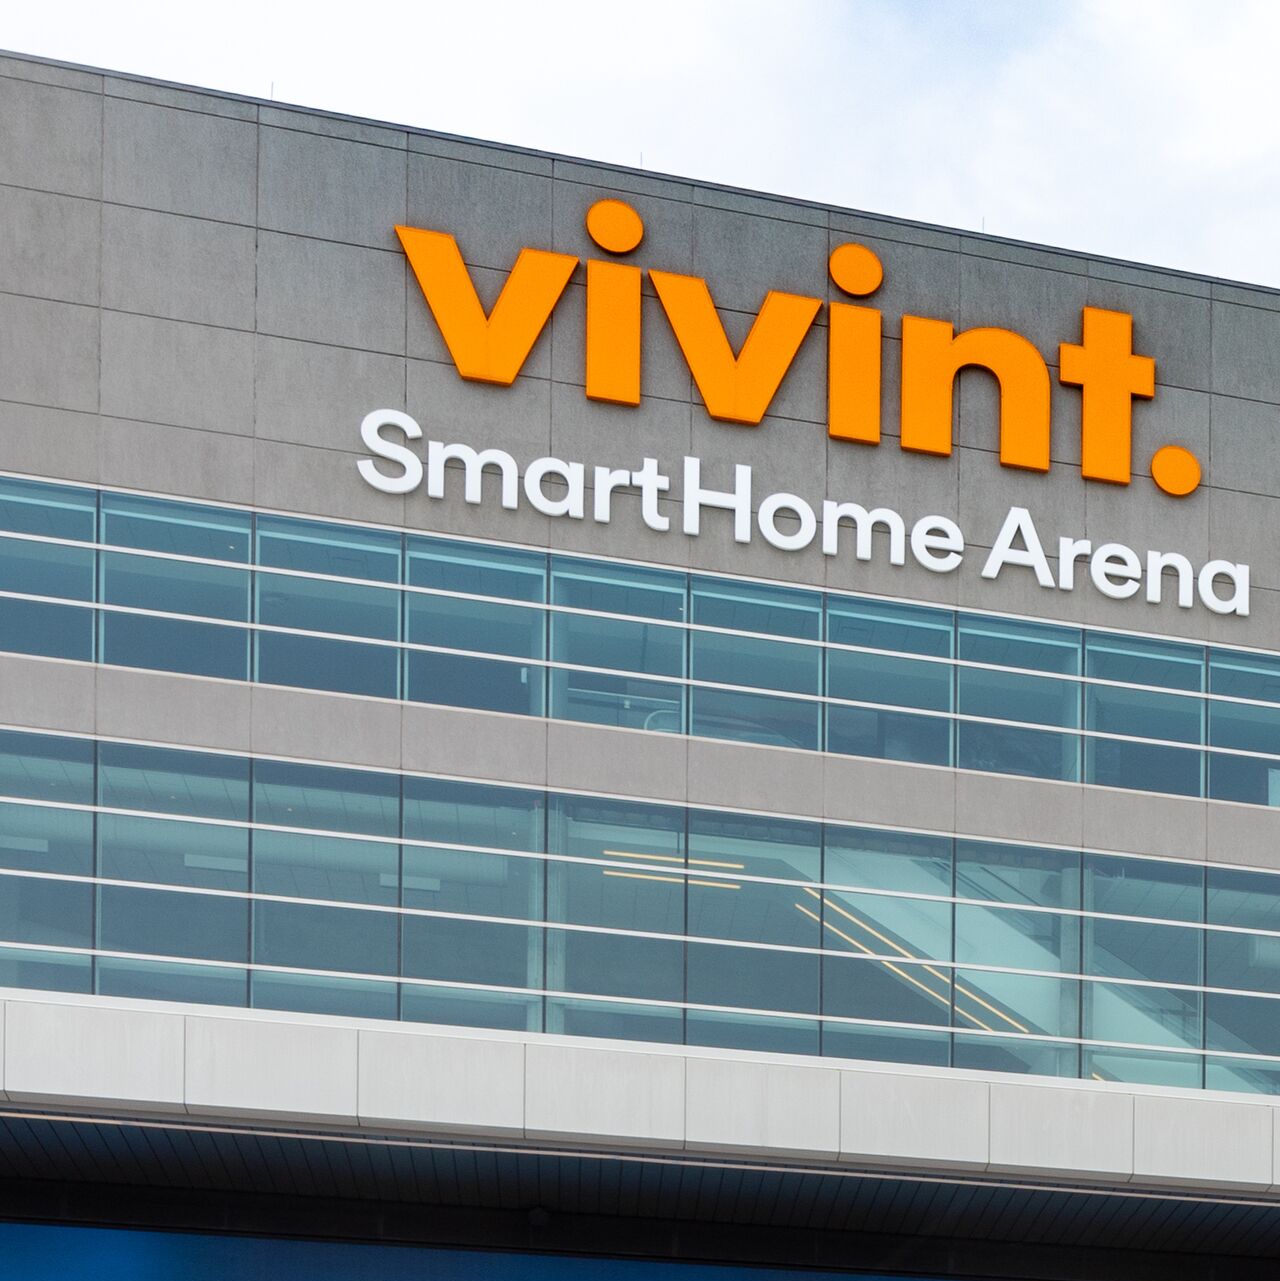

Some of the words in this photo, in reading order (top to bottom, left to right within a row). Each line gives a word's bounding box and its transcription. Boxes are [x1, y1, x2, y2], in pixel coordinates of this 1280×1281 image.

[393, 199, 1201, 498] vivint.
[356, 407, 964, 574] SmartHome
[981, 505, 1252, 618] Arena
